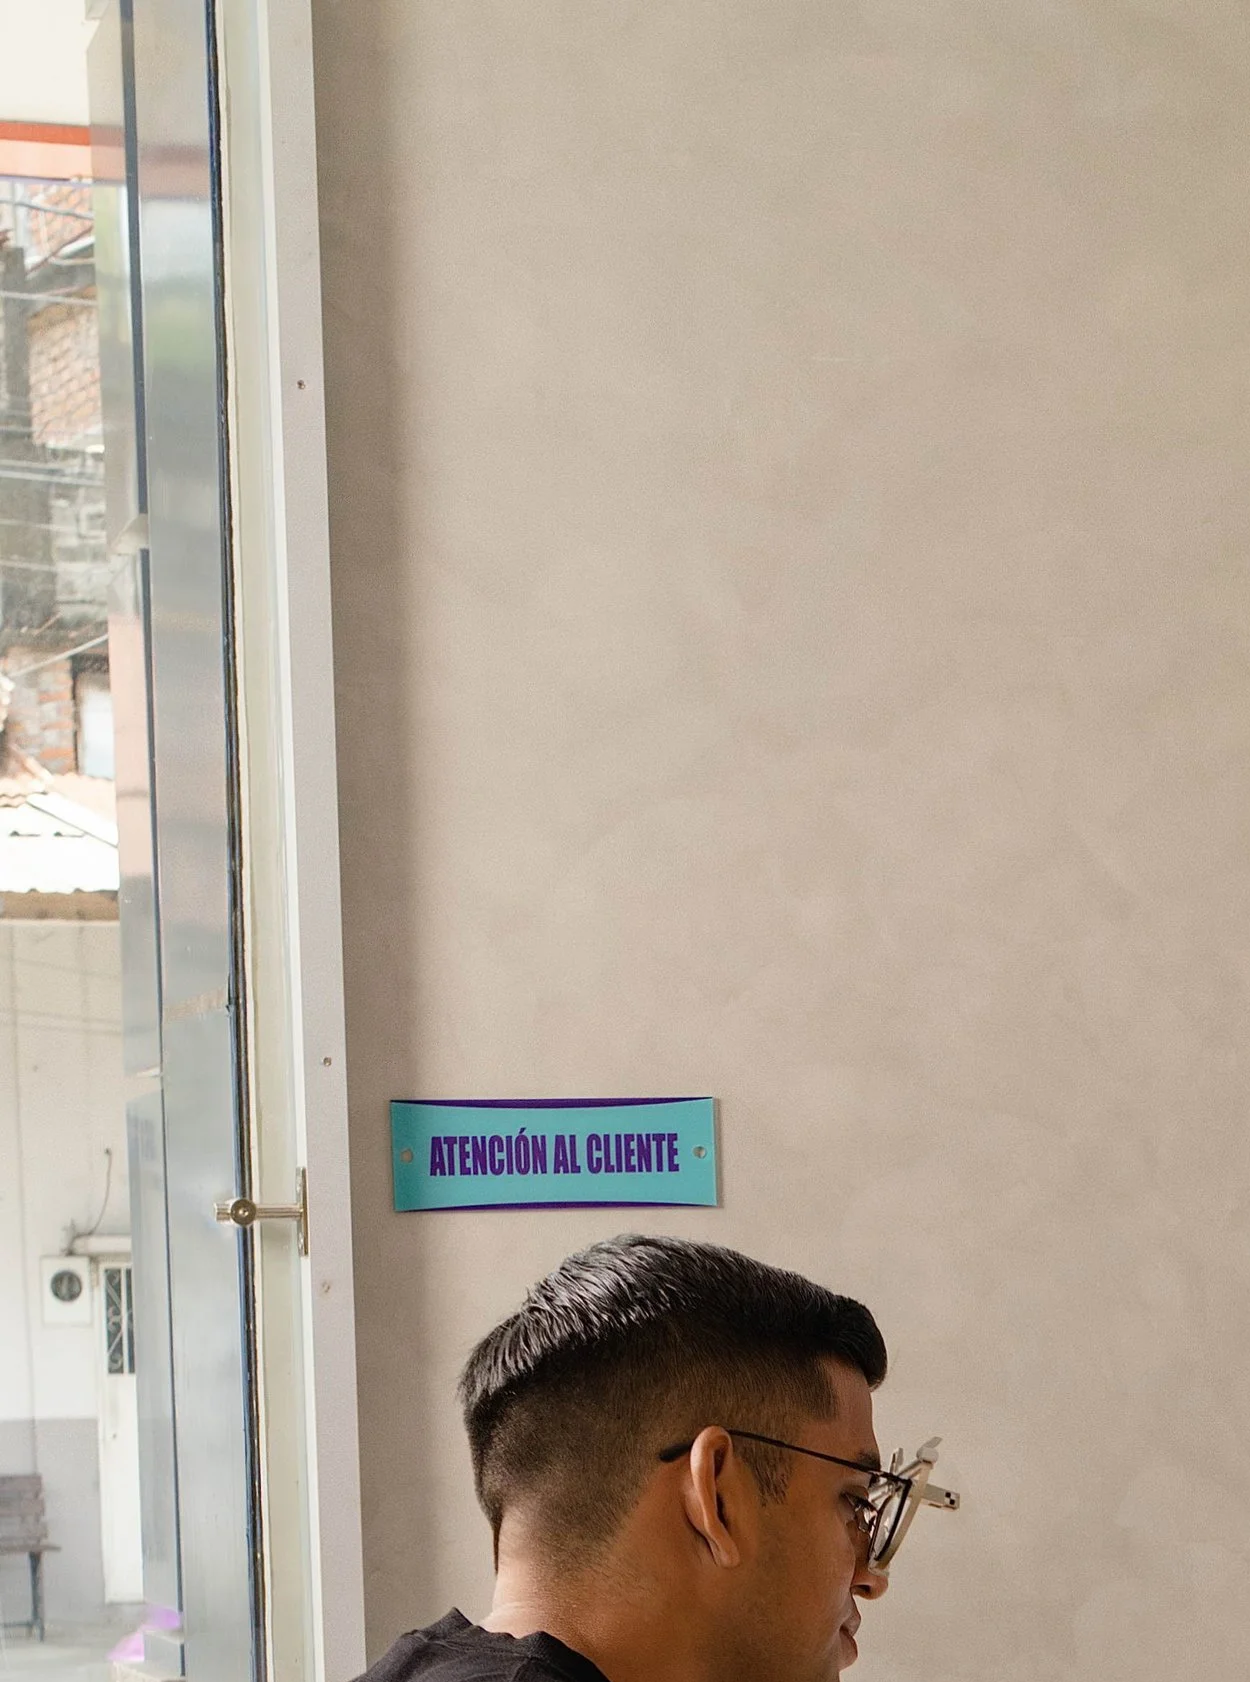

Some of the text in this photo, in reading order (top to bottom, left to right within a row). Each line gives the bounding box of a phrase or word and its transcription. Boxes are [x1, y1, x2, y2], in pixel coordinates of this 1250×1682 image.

[429, 1127, 680, 1176] ATENCIÓN AL CLIENTE
